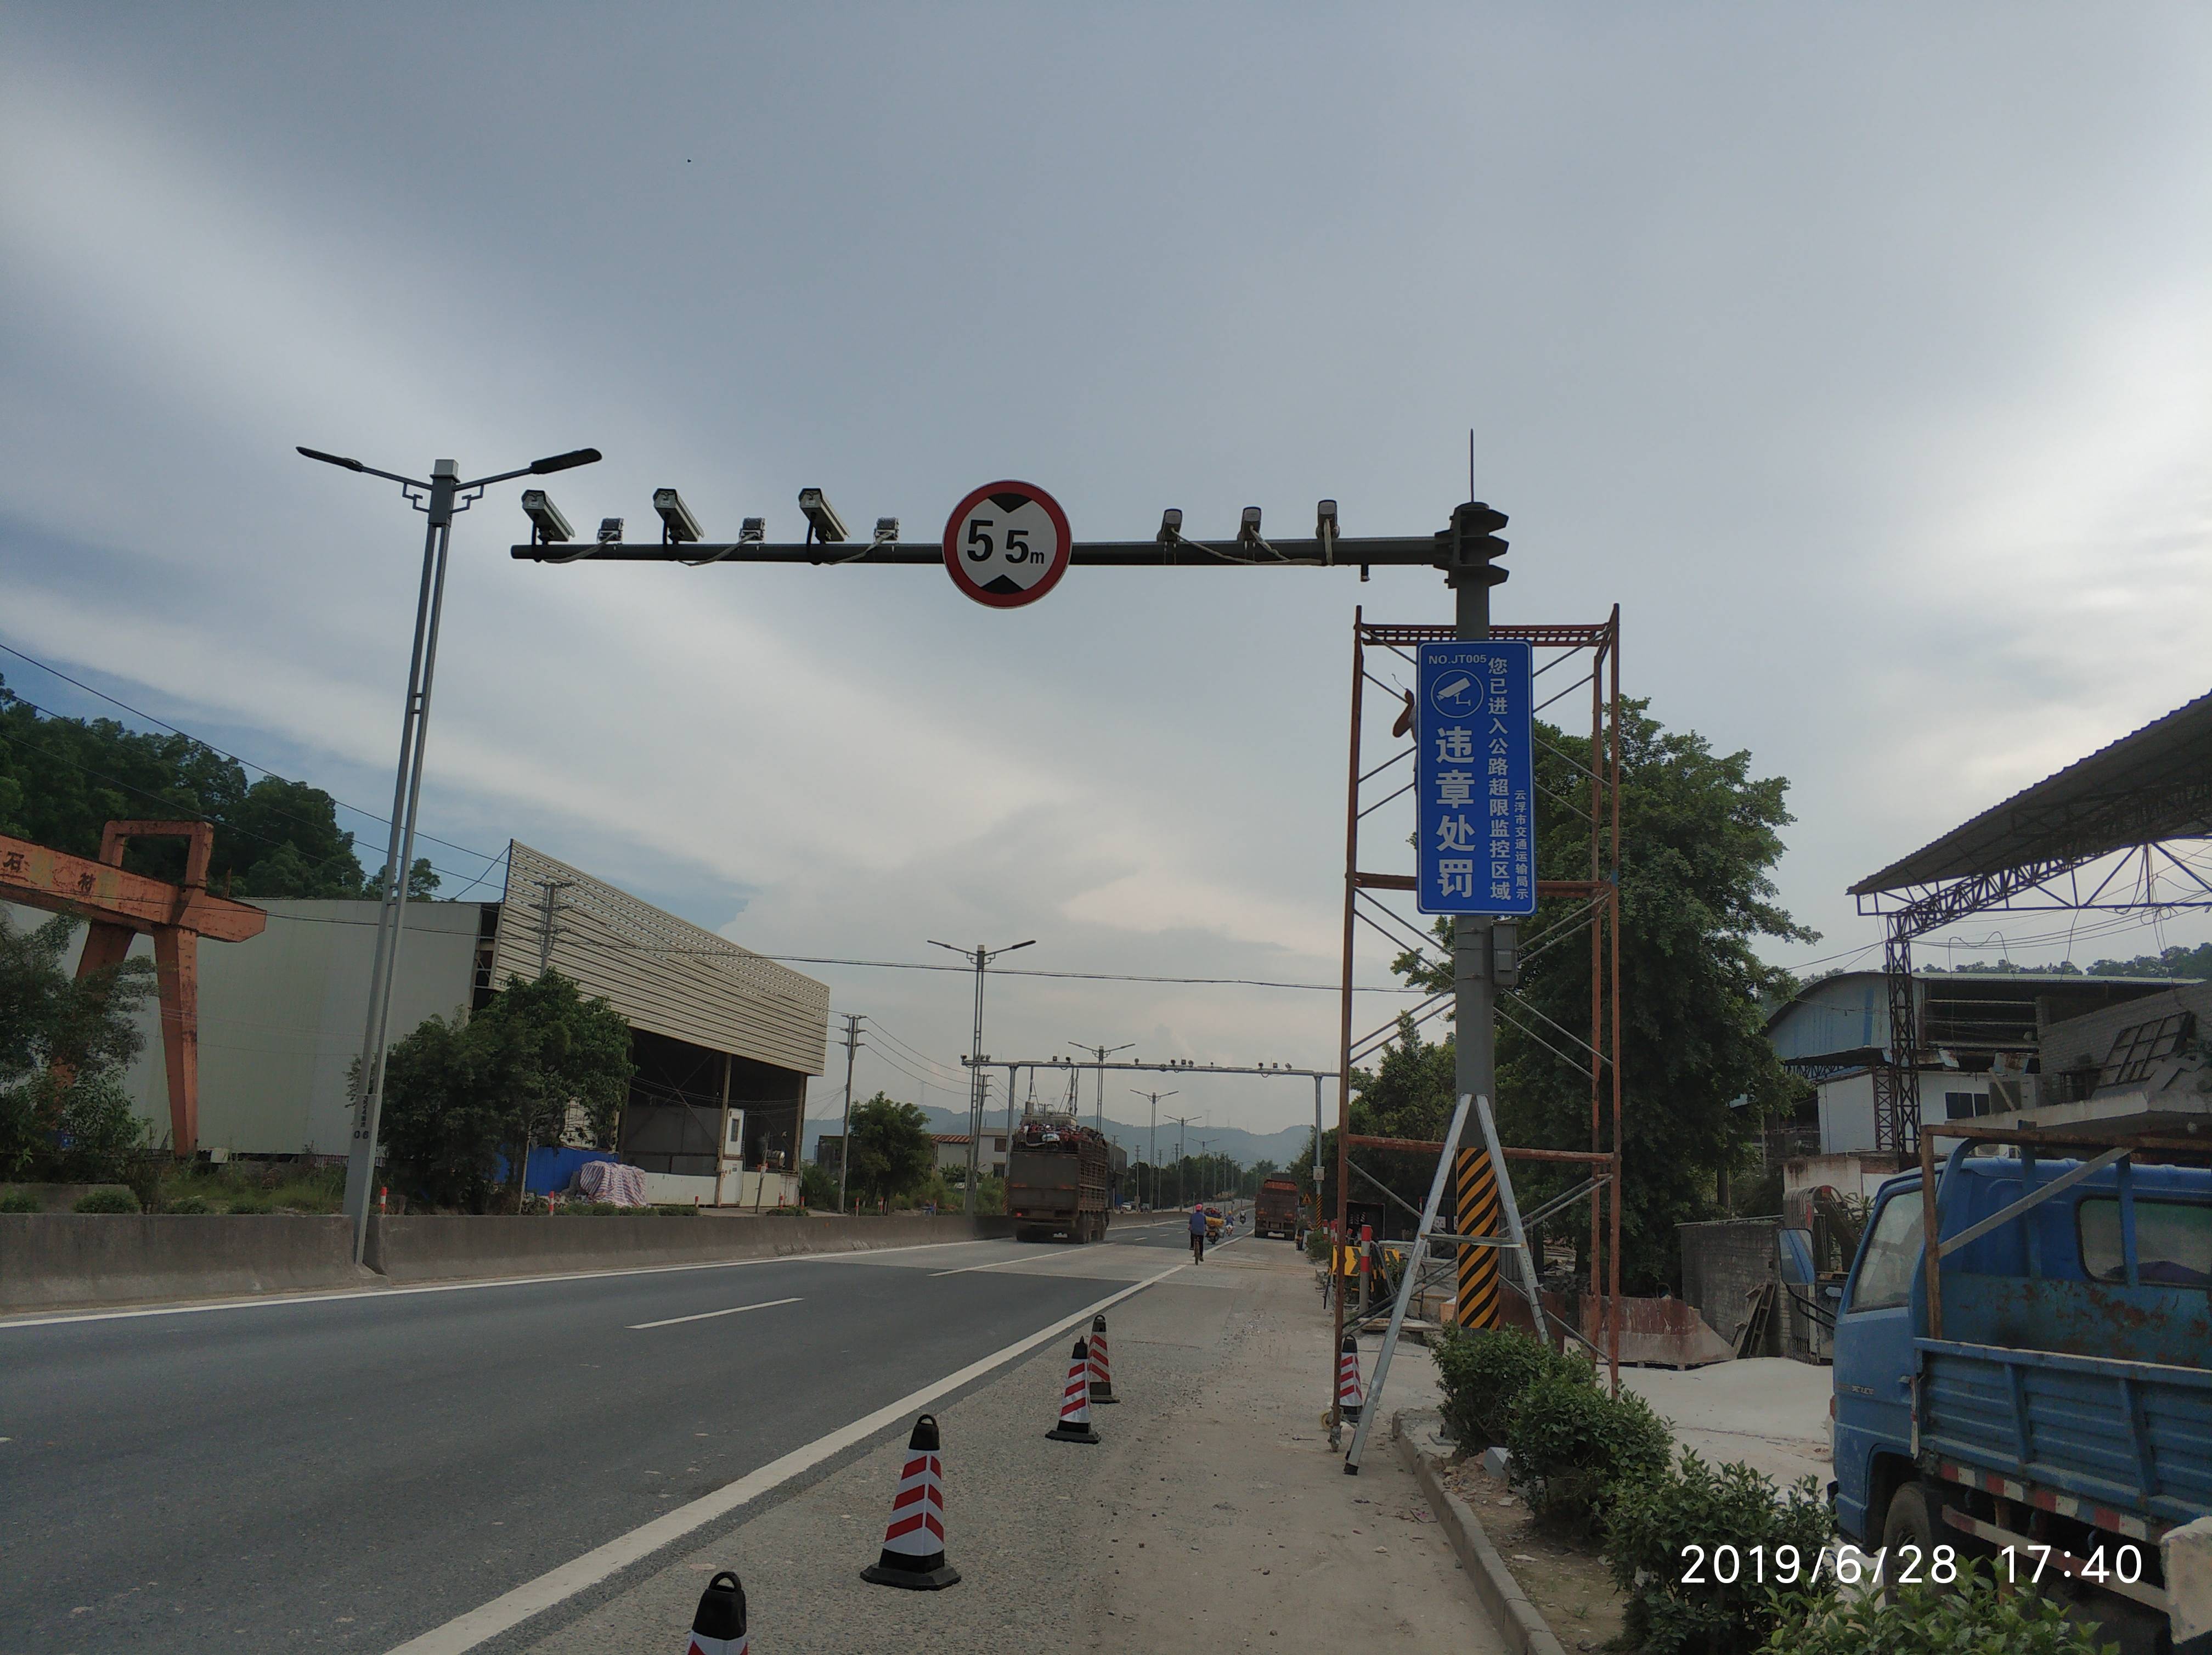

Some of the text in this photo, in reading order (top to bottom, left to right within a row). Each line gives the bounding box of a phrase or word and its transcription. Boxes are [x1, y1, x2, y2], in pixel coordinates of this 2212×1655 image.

[1429, 655, 1487, 665] NO.JT005
[1435, 725, 1475, 898] 违章处罚
[1487, 657, 1511, 900] 您已进入公路超限监控区域
[1514, 790, 1528, 899] 云浮市交通运输局示
